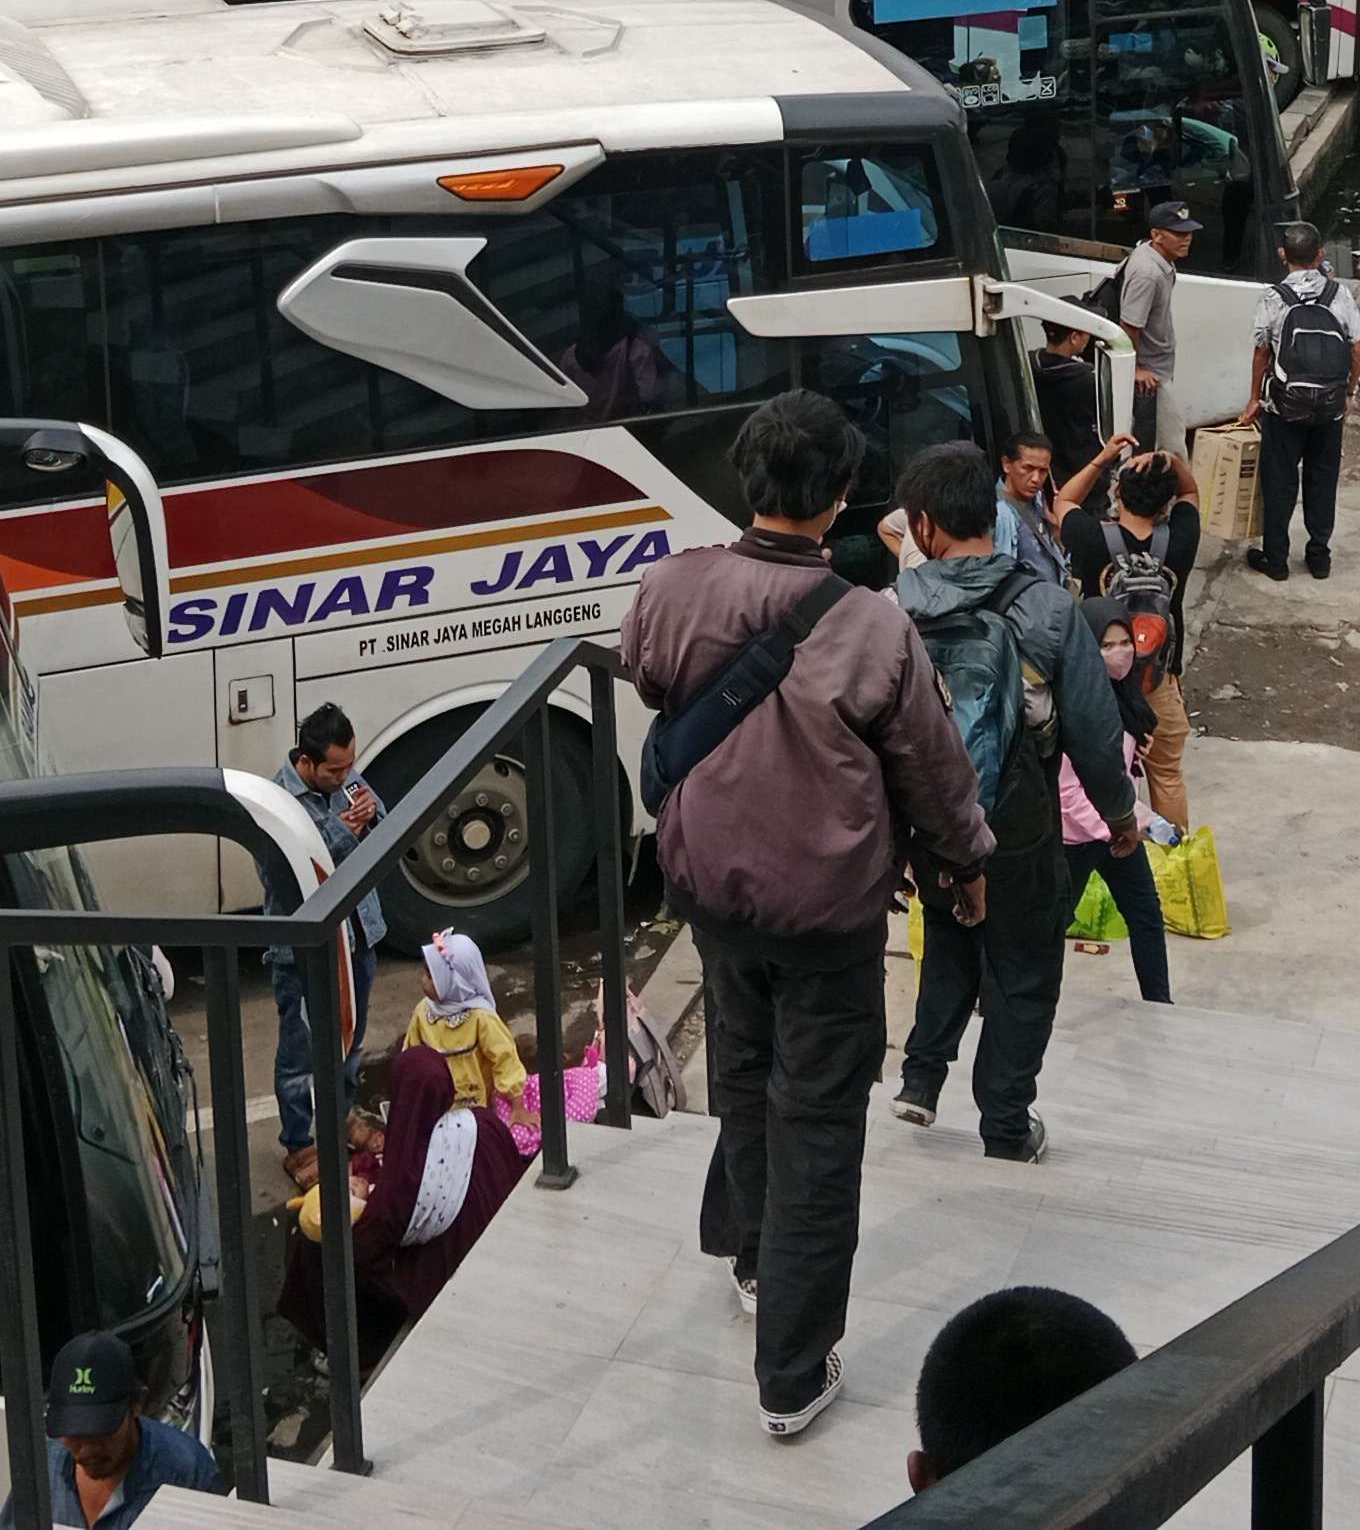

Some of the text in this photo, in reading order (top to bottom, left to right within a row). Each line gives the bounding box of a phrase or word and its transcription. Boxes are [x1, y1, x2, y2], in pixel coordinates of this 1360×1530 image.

[168, 529, 673, 644] SINAR JAYA
[359, 638, 377, 657] PT
[433, 624, 468, 644] JAYA
[472, 615, 521, 638] MEGAH
[526, 603, 601, 629] LANGGENG
